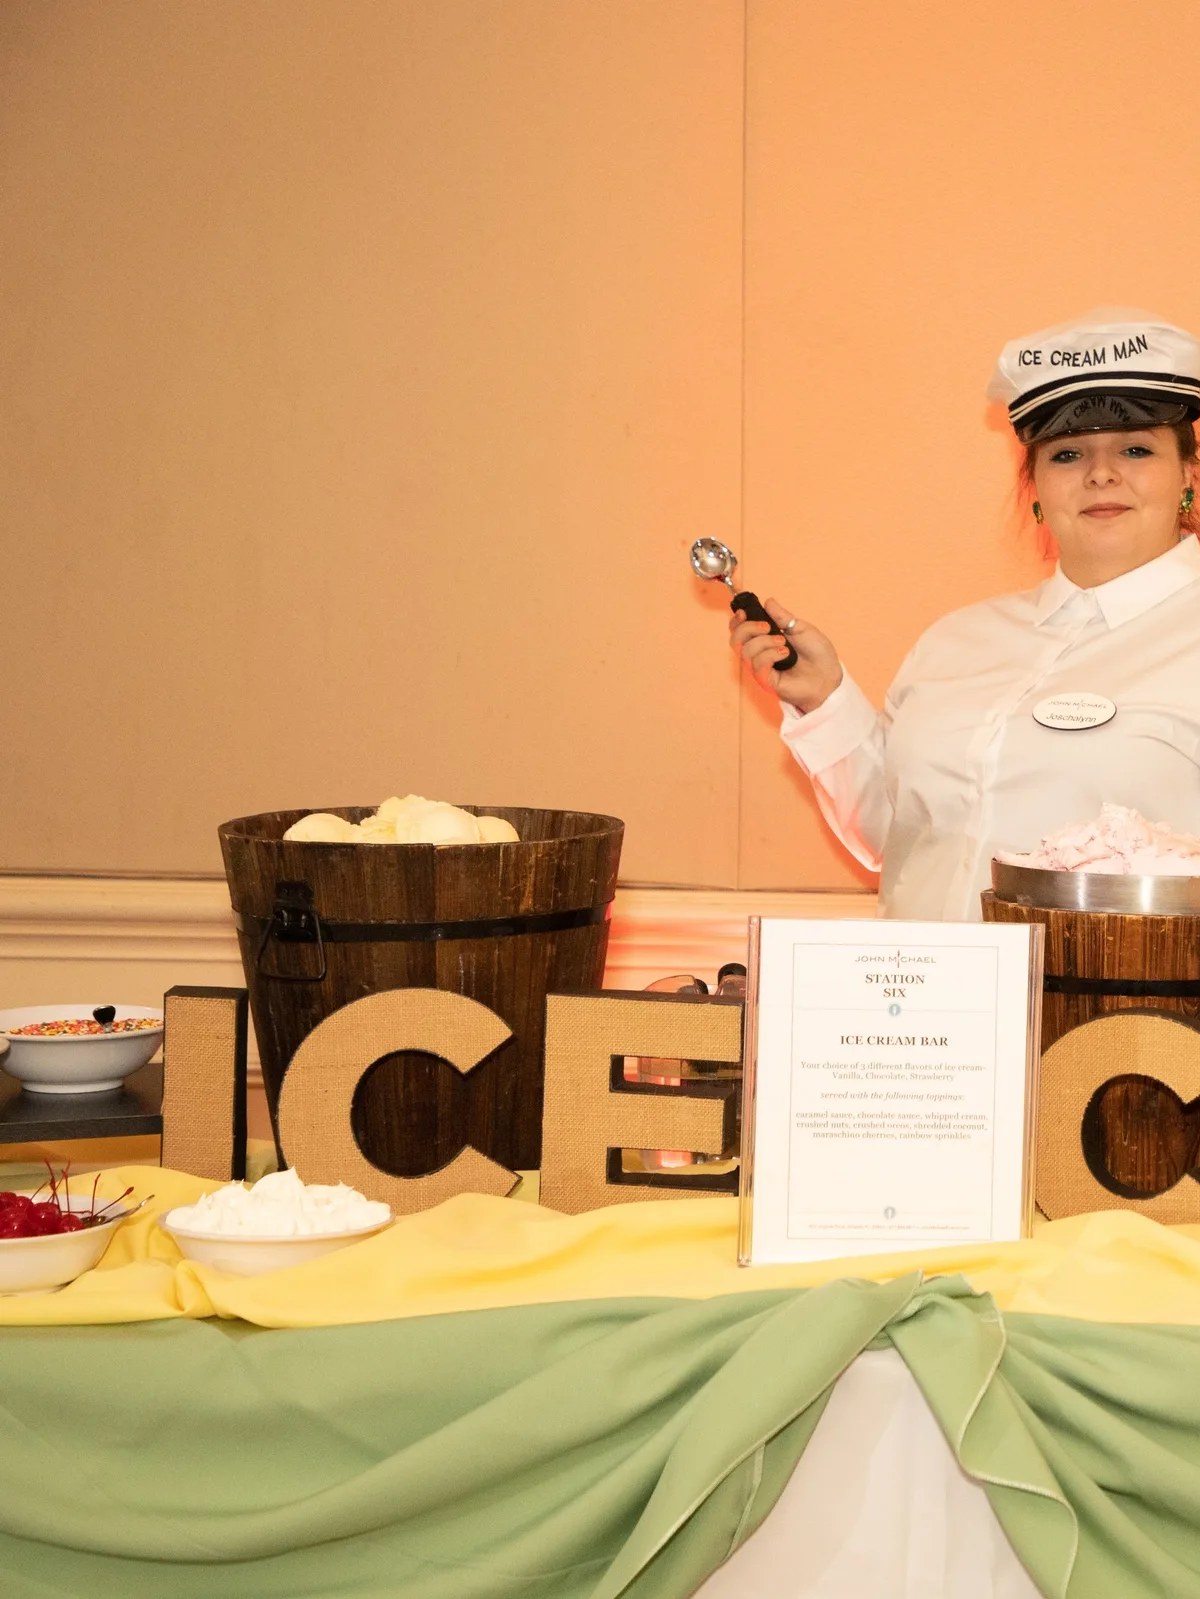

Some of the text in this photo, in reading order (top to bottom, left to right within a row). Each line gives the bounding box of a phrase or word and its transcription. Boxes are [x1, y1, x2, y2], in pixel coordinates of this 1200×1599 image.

[1018, 334, 1149, 367] ICE CREAM MAN
[855, 955, 885, 963] JOHN
[865, 973, 925, 984] STATION
[883, 988, 907, 998] SIX
[840, 1035, 949, 1047] ICE CREAM BAR
[801, 1061, 820, 1070] Your
[822, 1061, 849, 1070] choice
[850, 1061, 859, 1070] of
[860, 1063, 866, 1071] 3
[867, 1061, 902, 1070] different
[904, 1062, 932, 1071] flavors
[934, 1062, 942, 1071] of
[944, 1062, 956, 1071] ice
[832, 1071, 954, 1082] Vanilla, Chocolate, Strawberry
[160, 986, 742, 1215] ICE
[820, 1091, 848, 1099] served
[850, 1091, 868, 1099] with
[870, 1091, 883, 1100] the
[884, 1091, 924, 1102] following
[796, 1110, 828, 1119] caramel
[830, 1111, 856, 1120] sauce,
[857, 1111, 895, 1120] chocolate
[924, 1111, 959, 1122] whipped
[796, 1120, 828, 1129] crushed
[831, 1121, 851, 1130] nuts,
[853, 1121, 885, 1129] crushed
[913, 1121, 951, 1130] shredded
[953, 1122, 988, 1132] coconut,
[812, 1130, 971, 1141] maraschino cherries, rainbow sprinkles
